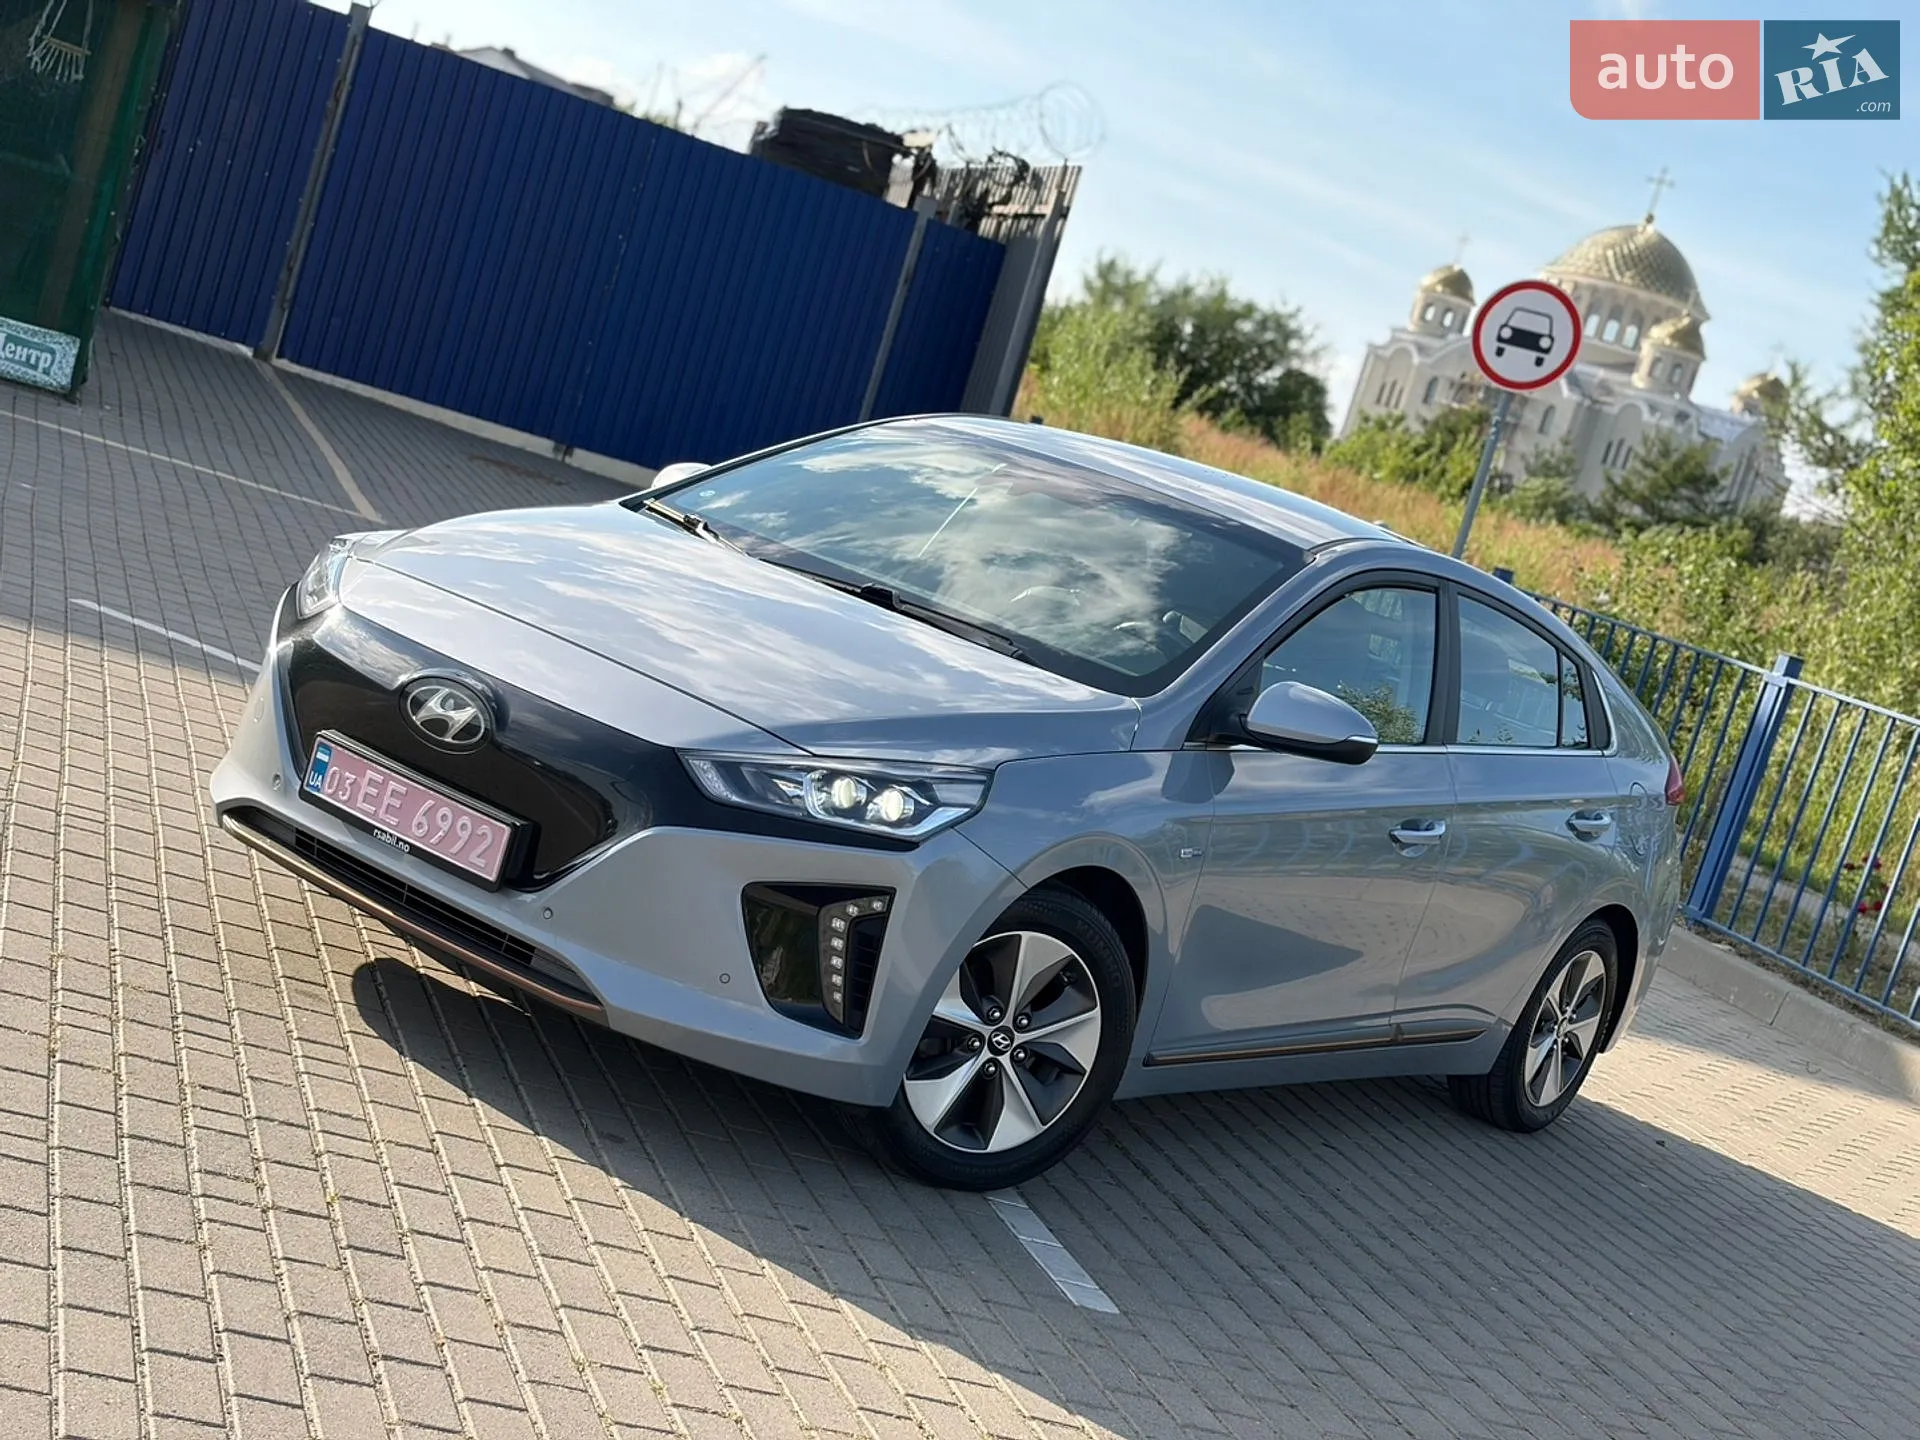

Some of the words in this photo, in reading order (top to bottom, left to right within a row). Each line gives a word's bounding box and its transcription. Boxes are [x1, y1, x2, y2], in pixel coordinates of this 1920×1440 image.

[309, 771, 322, 789] UA
[324, 766, 356, 801] 03
[357, 770, 407, 825] EE
[411, 799, 493, 868] 6992
[373, 828, 410, 853] rsabil.no
